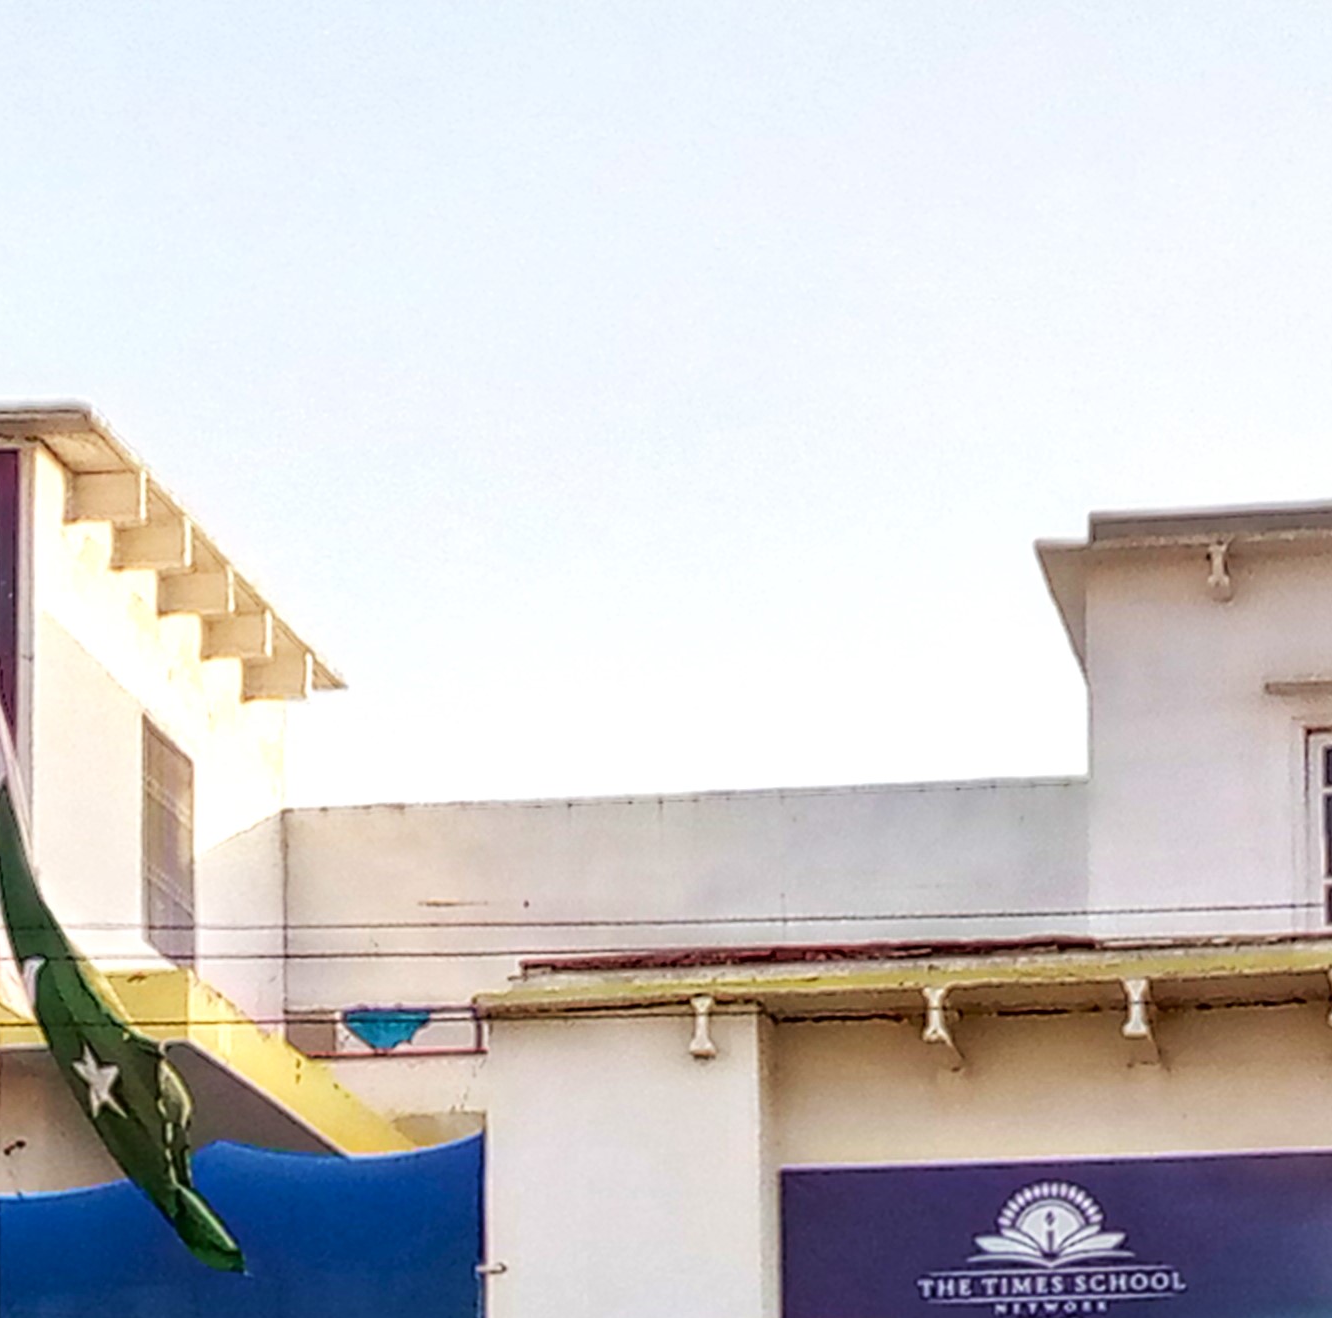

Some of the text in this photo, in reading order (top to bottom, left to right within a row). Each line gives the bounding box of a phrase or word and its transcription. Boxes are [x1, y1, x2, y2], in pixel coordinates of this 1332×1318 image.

[917, 1271, 1187, 1298] THE TIMES SCHOOL
